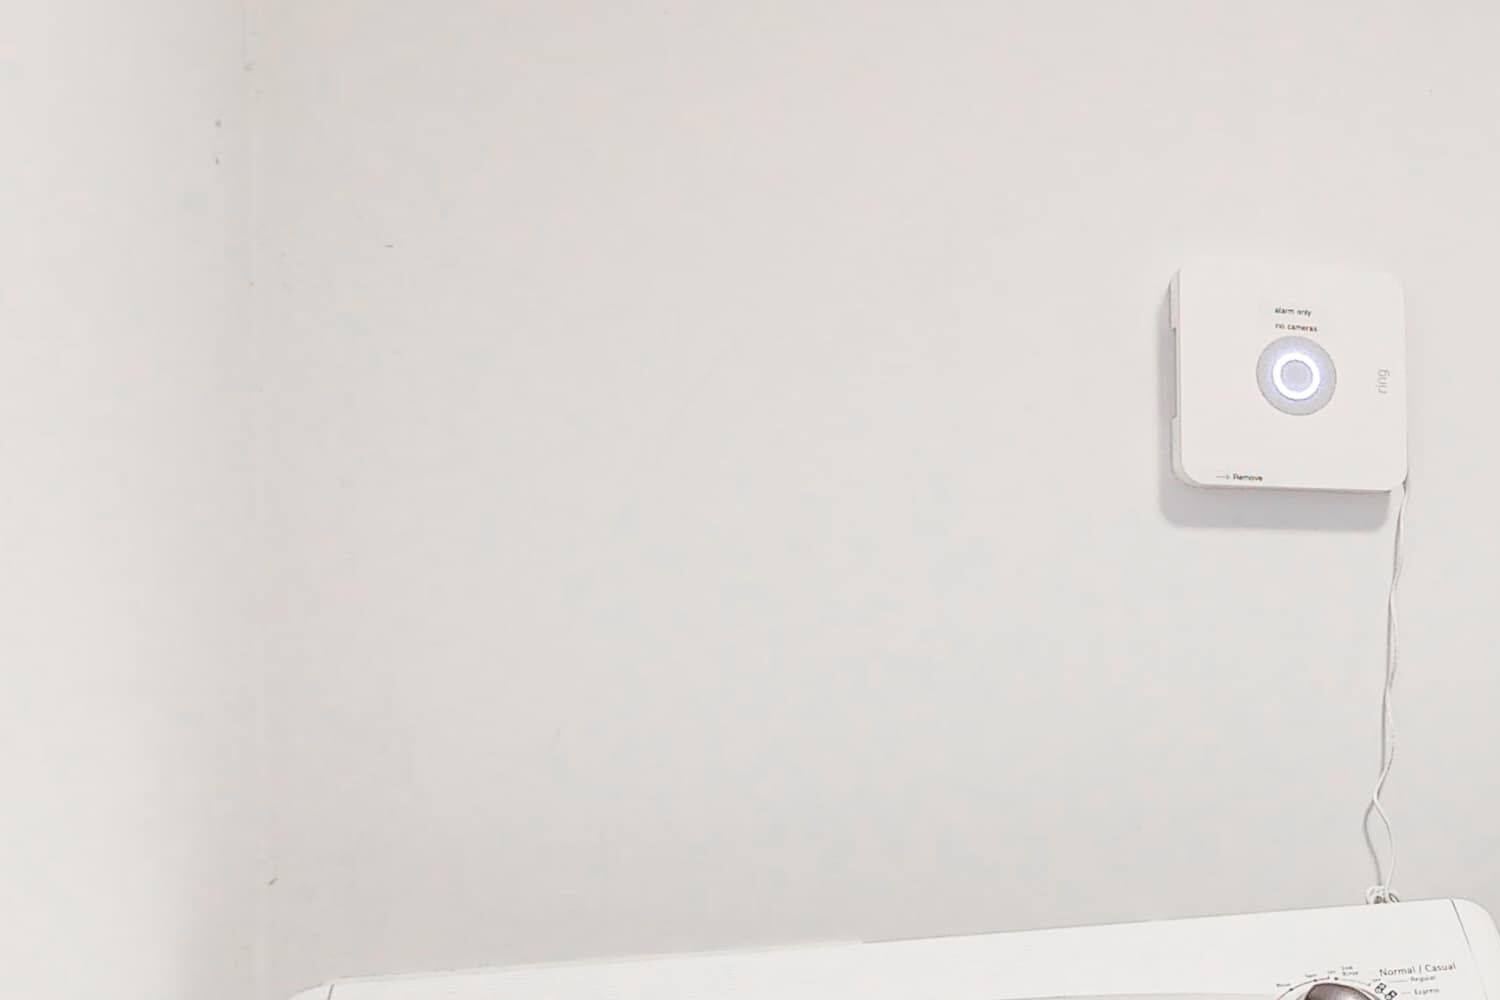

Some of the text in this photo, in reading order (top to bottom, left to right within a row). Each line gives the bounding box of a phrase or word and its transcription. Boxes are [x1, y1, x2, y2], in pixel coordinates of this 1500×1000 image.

[1274, 306, 1312, 317] alarm only
[1287, 324, 1318, 332] cameras
[1375, 368, 1391, 395] ring
[1232, 473, 1264, 482] Remove
[1379, 965, 1417, 977] Normal
[1424, 962, 1457, 974] Casual
